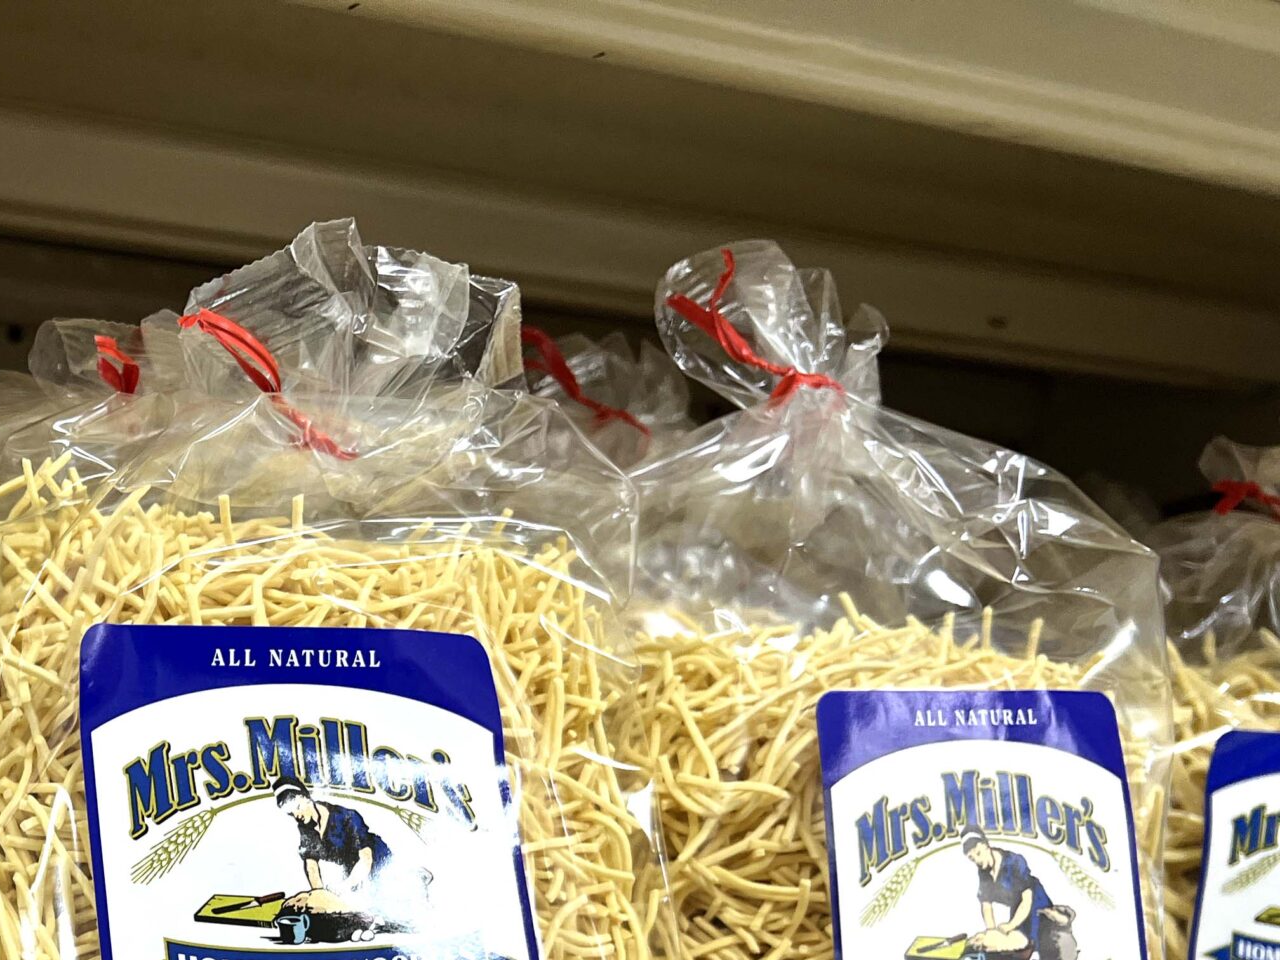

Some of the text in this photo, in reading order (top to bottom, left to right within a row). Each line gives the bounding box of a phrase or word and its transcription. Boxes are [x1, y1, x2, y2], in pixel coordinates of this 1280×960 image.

[211, 648, 381, 669] ALL NATURAL
[914, 708, 1038, 727] ALL NATURAL
[122, 740, 254, 840] Mrs.
[854, 769, 1111, 887] Mrs. Miller's
